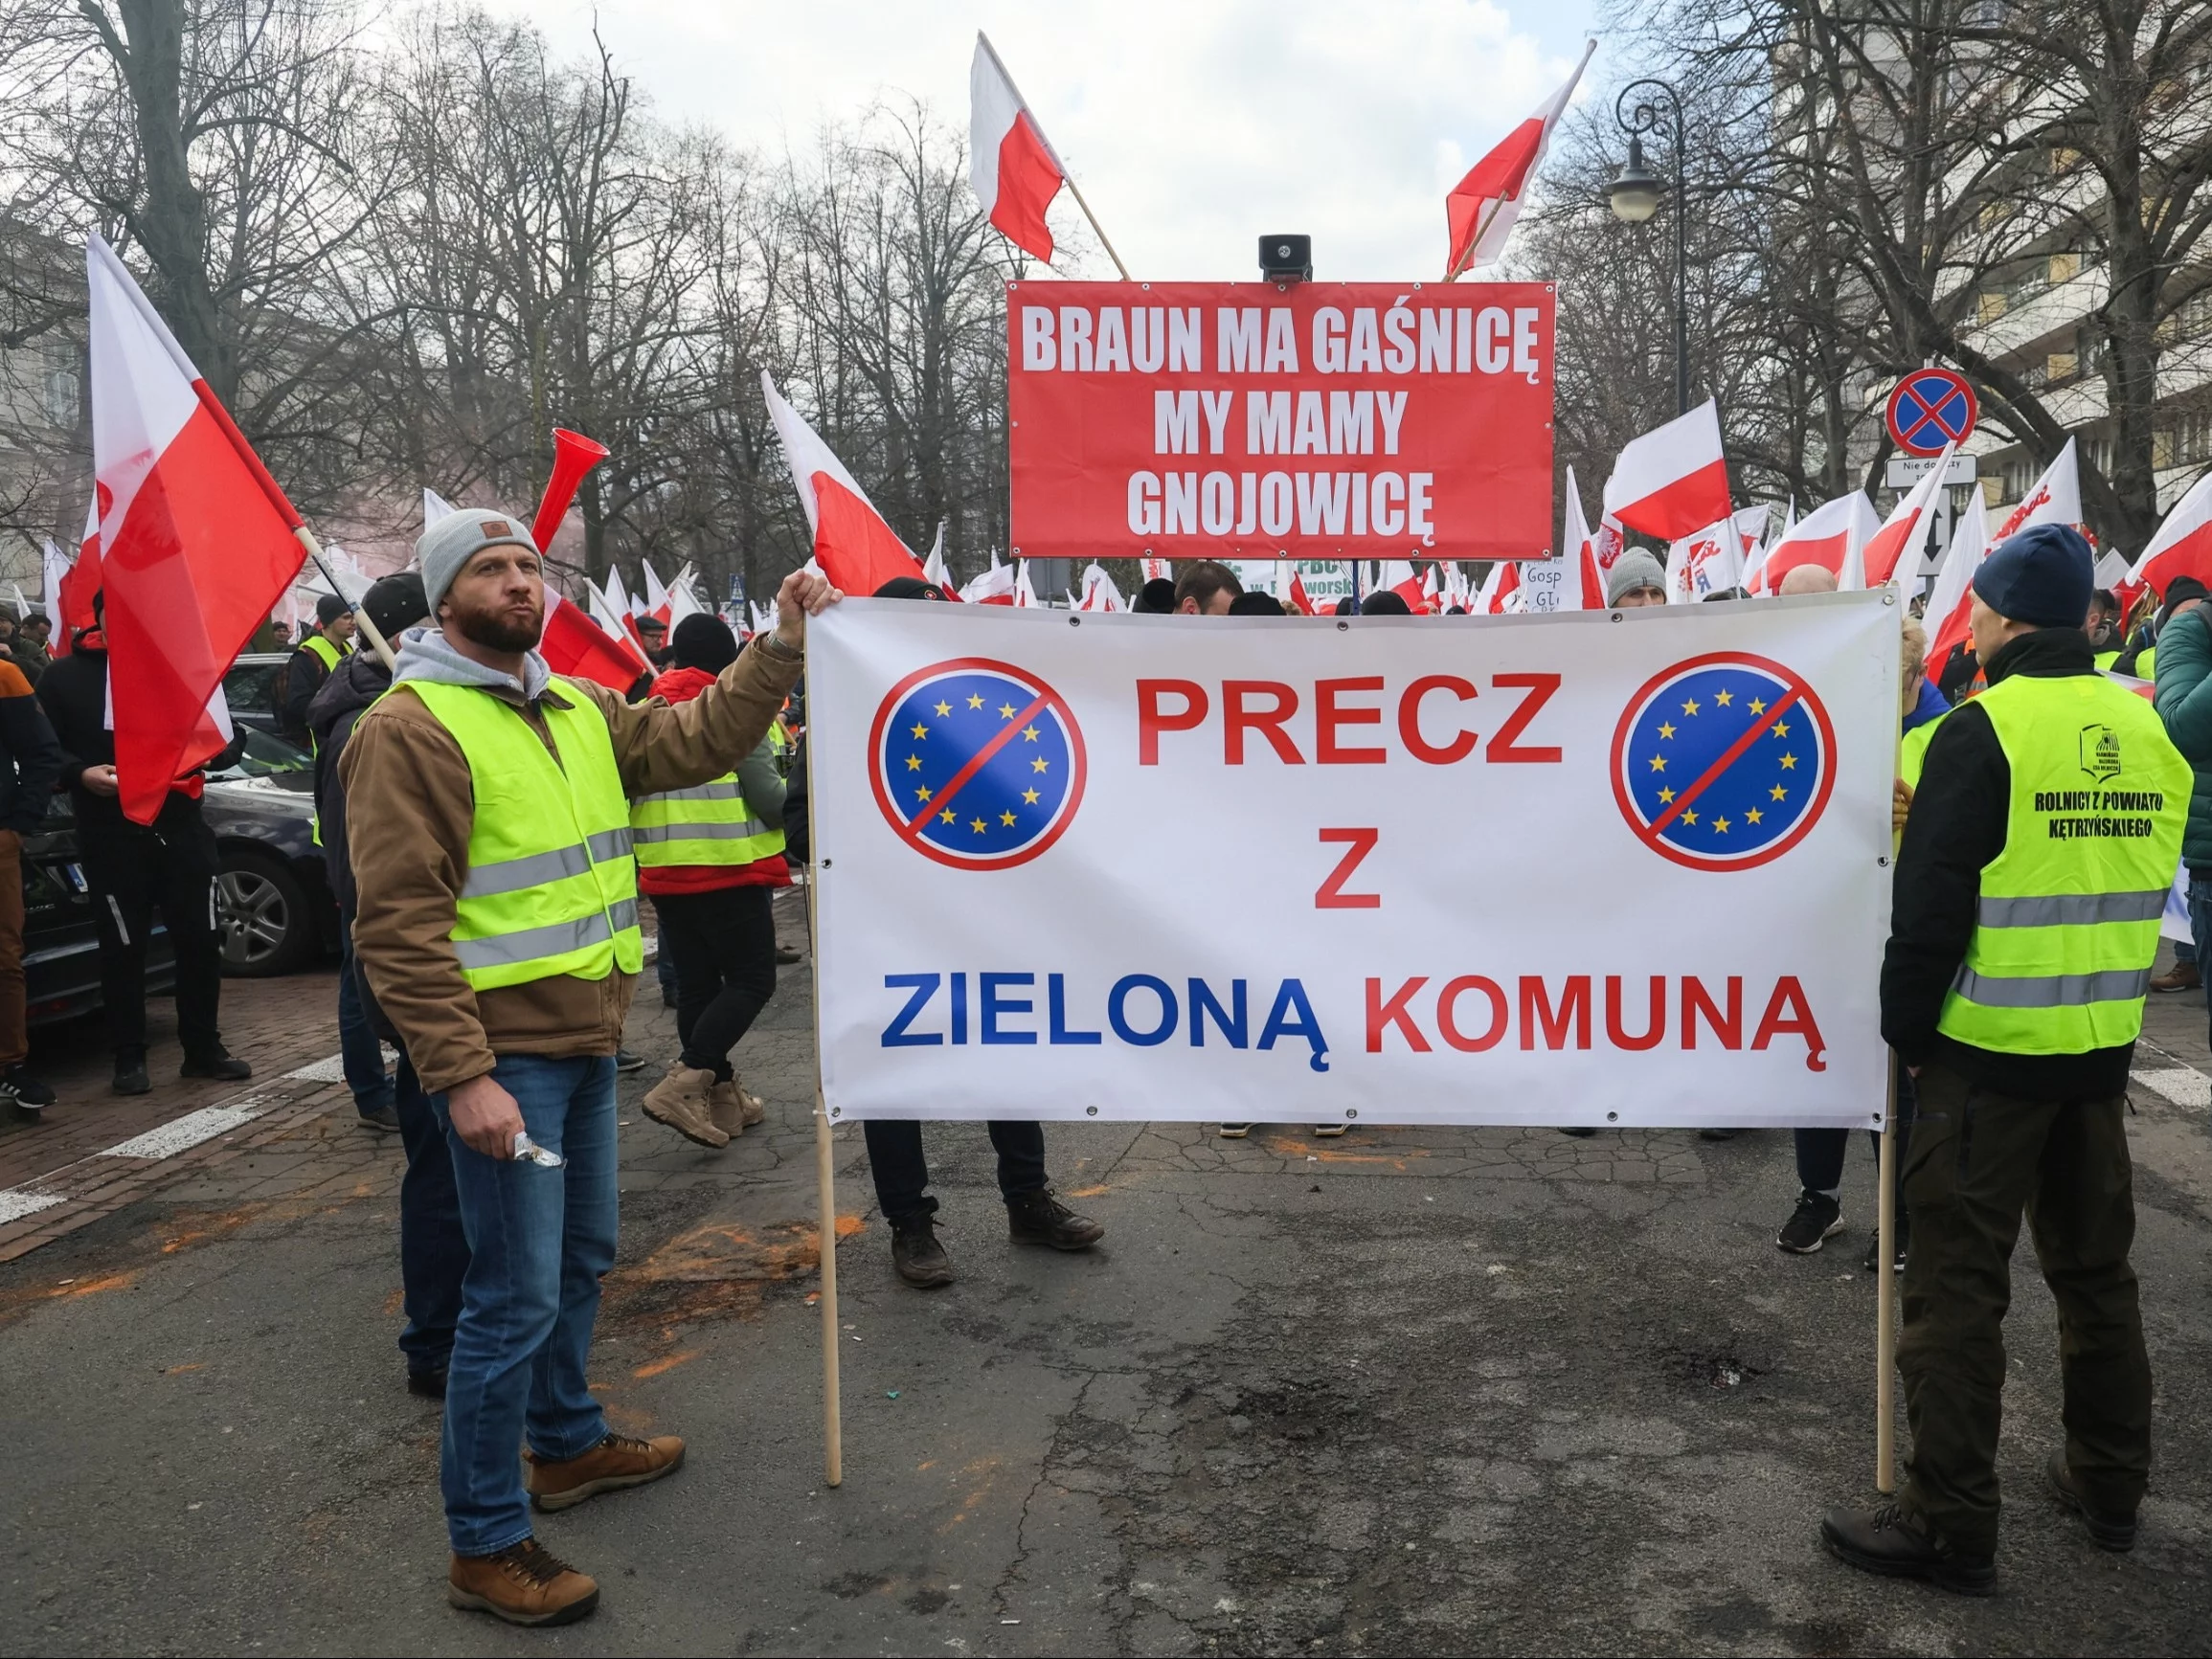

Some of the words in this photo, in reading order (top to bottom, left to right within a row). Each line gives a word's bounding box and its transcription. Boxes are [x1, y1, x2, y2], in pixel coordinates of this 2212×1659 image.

[1022, 307, 1202, 372] BRAUN
[1217, 308, 1299, 372] MA
[1313, 296, 1540, 385] GAŚNICĘ
[1155, 391, 1233, 455] MY
[1248, 392, 1409, 455] MAMY
[1128, 471, 1434, 547] GNOJOWICĘ
[1138, 673, 1564, 766] PRECZ
[2035, 791, 2091, 812] ROLNICY
[2092, 791, 2100, 810] Z
[2102, 792, 2163, 812] POWIATU
[2048, 815, 2153, 841] KĘTRZYŃSKIEGO
[1316, 828, 1382, 909] Z
[881, 972, 1331, 1073] ZIELONĄ
[1366, 975, 1828, 1073] KOMUNĄ
